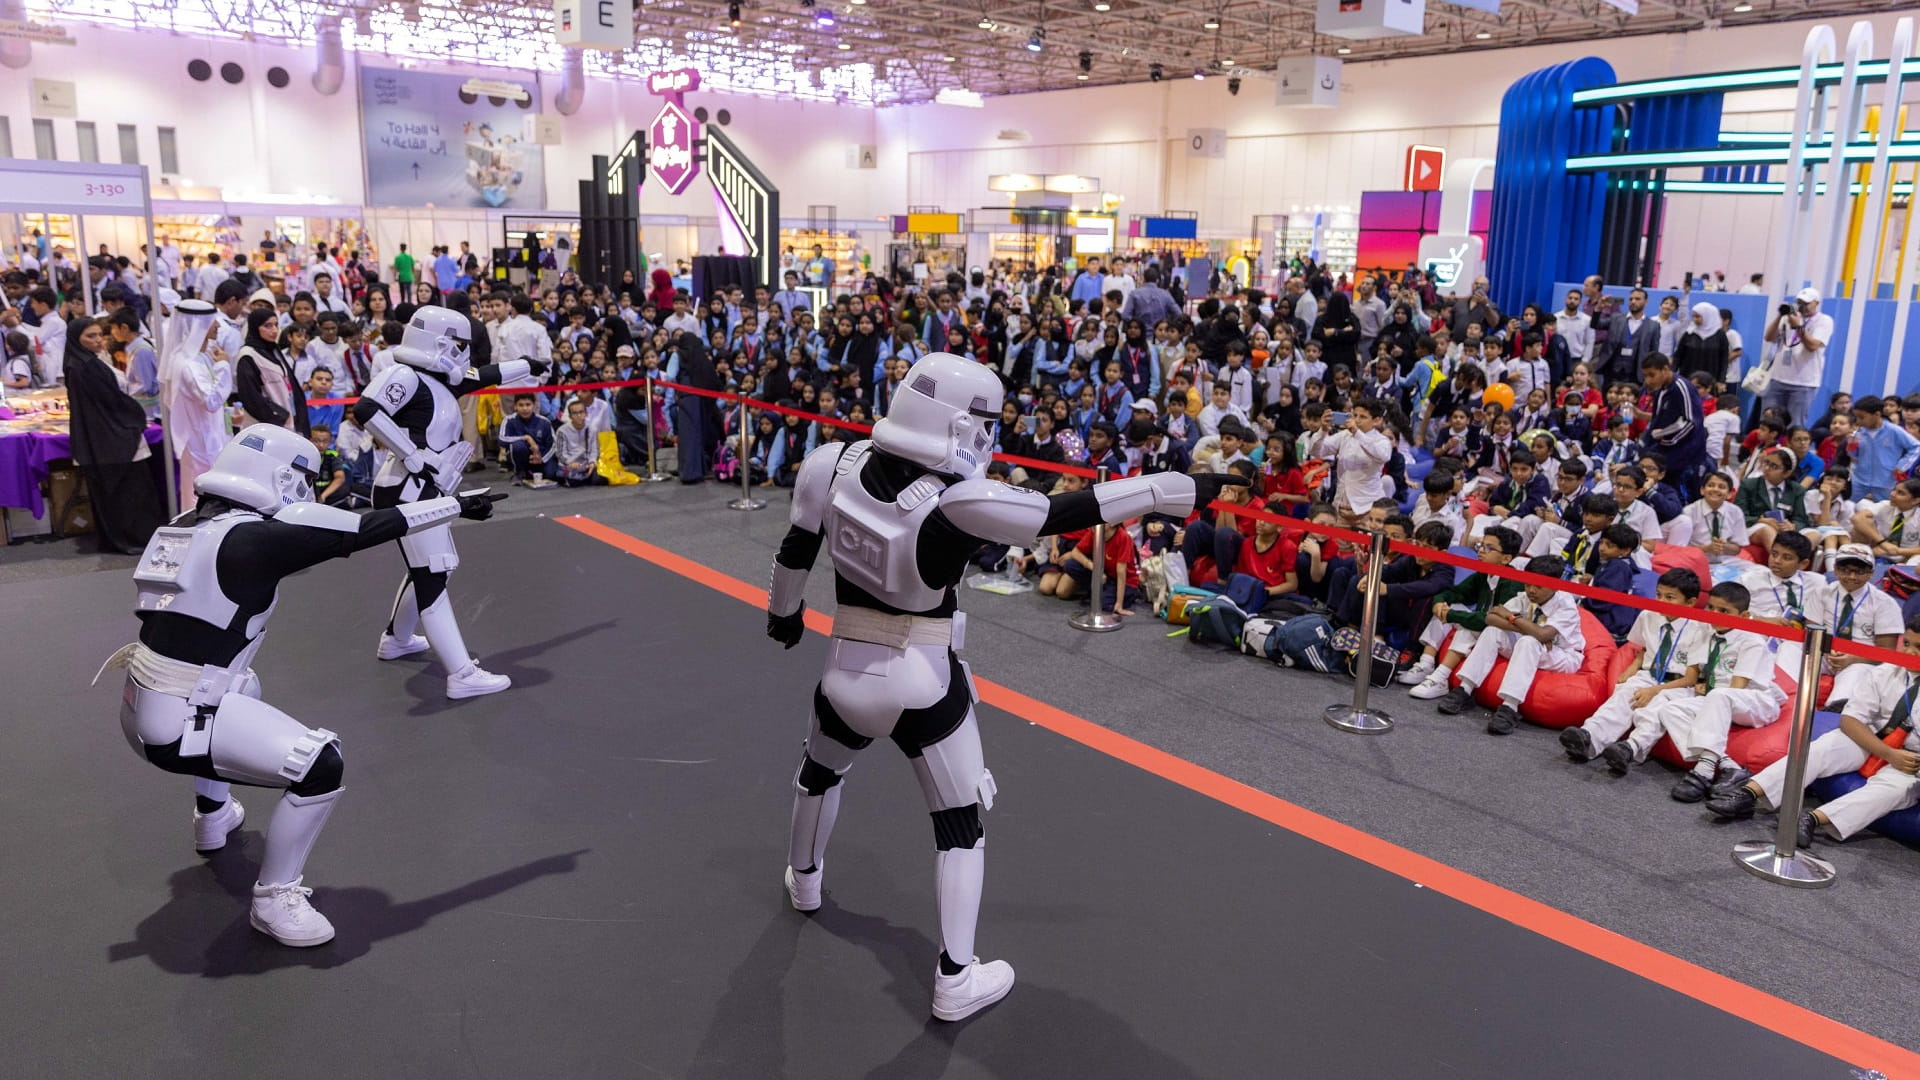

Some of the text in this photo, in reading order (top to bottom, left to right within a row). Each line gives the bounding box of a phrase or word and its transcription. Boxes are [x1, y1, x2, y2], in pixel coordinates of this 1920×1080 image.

[598, 1, 615, 28] E
[387, 121, 440, 136] To Hall 4
[85, 183, 125, 197] 3-130
